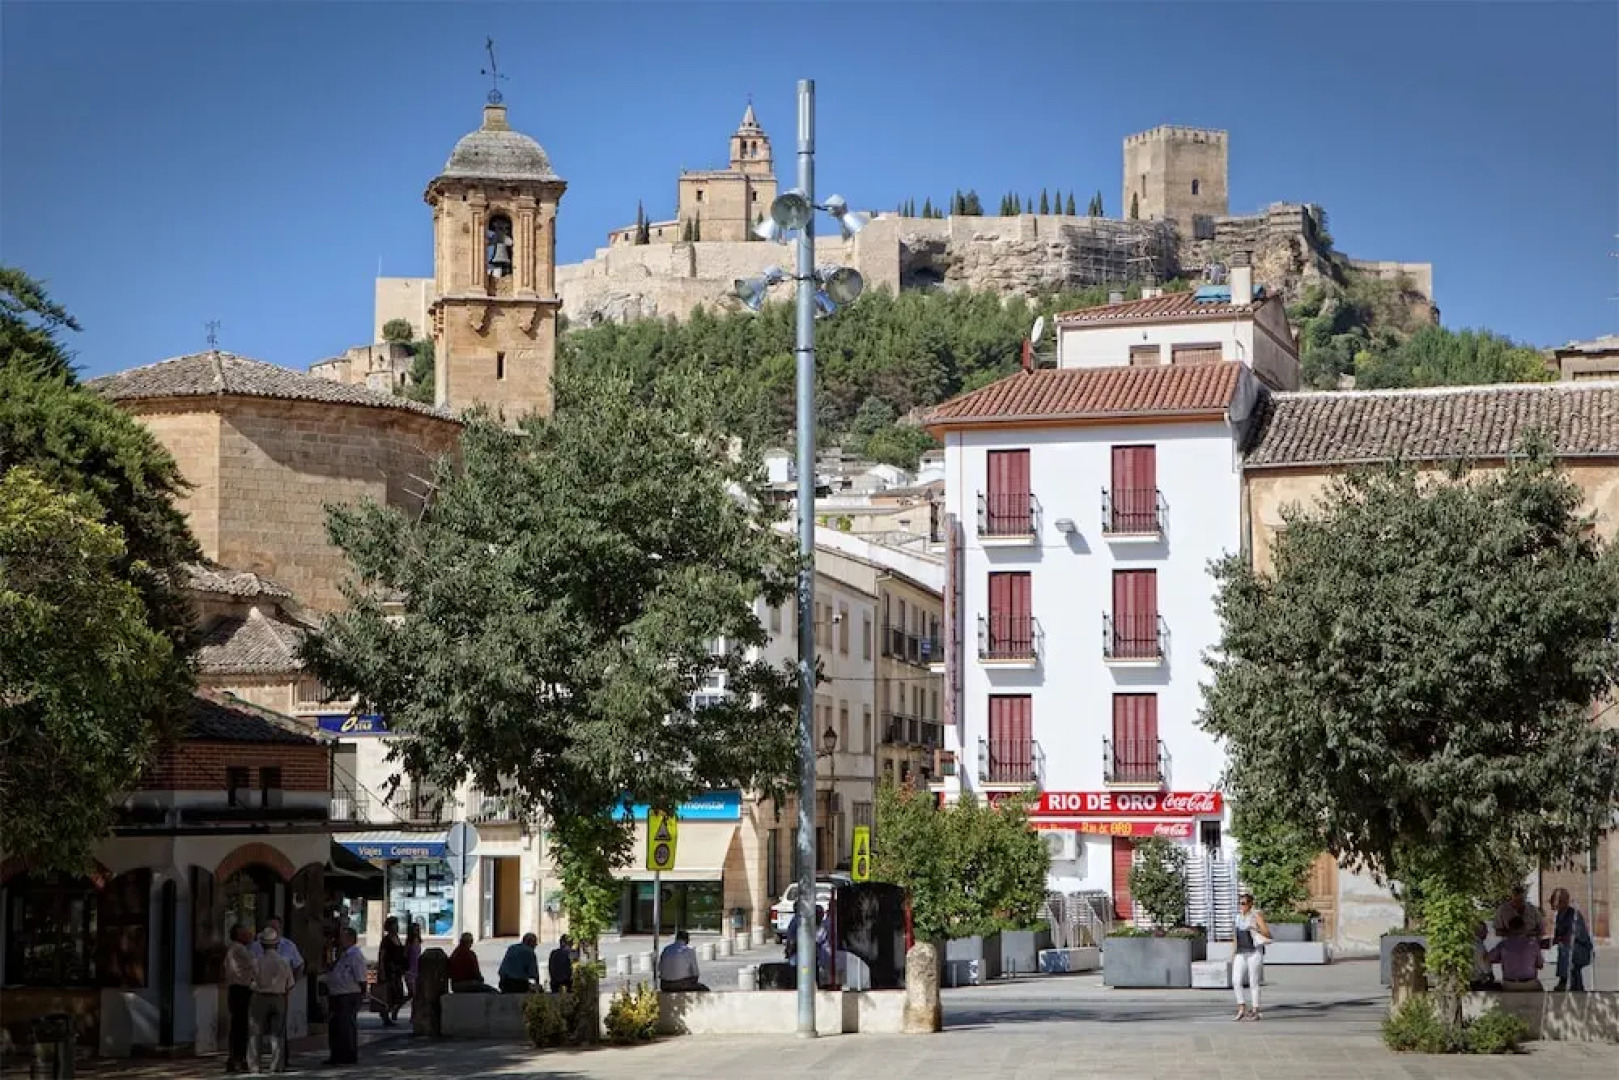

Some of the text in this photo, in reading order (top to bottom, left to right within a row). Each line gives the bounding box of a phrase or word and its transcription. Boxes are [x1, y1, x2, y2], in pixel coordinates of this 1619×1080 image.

[1048, 794, 1081, 811] RIO
[1087, 794, 1112, 811] DE
[1116, 794, 1157, 811] ORO
[1161, 793, 1214, 811] Coca-Cola
[1110, 822, 1133, 834] ORO
[358, 846, 430, 857] Viajes Contreras
